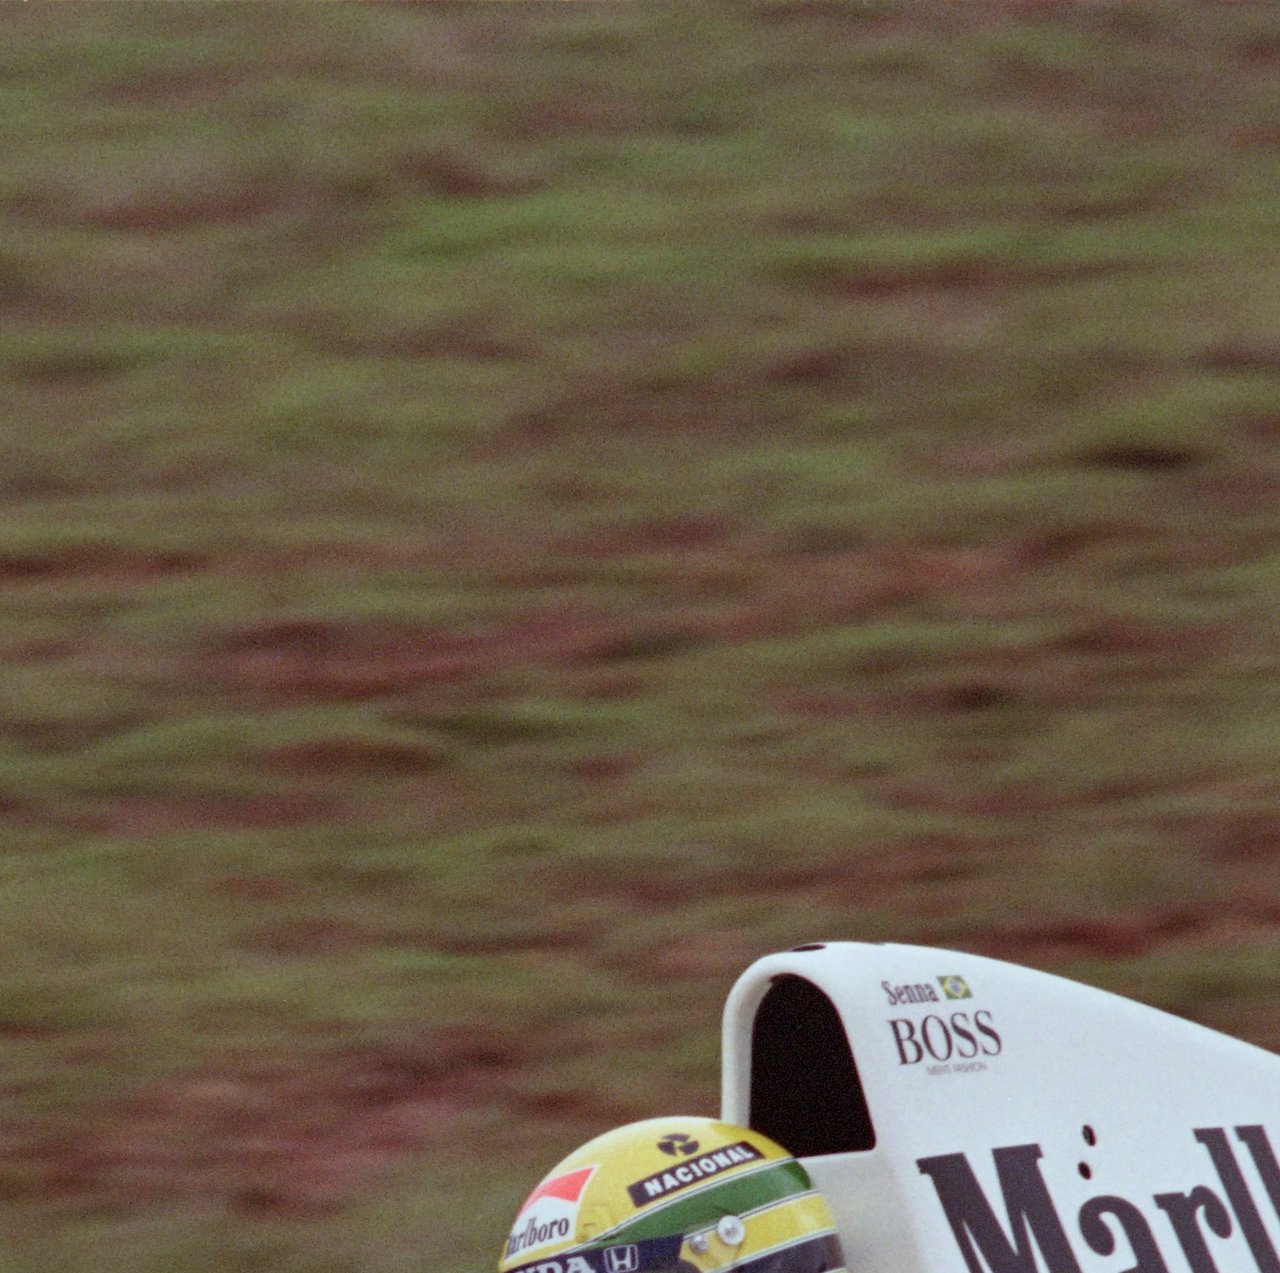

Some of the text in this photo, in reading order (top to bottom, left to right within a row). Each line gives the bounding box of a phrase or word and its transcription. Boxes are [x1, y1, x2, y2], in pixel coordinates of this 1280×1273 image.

[881, 979, 940, 1006] Senna
[887, 1010, 1002, 1065] BOSS
[643, 1146, 755, 1197] NACIONAL
